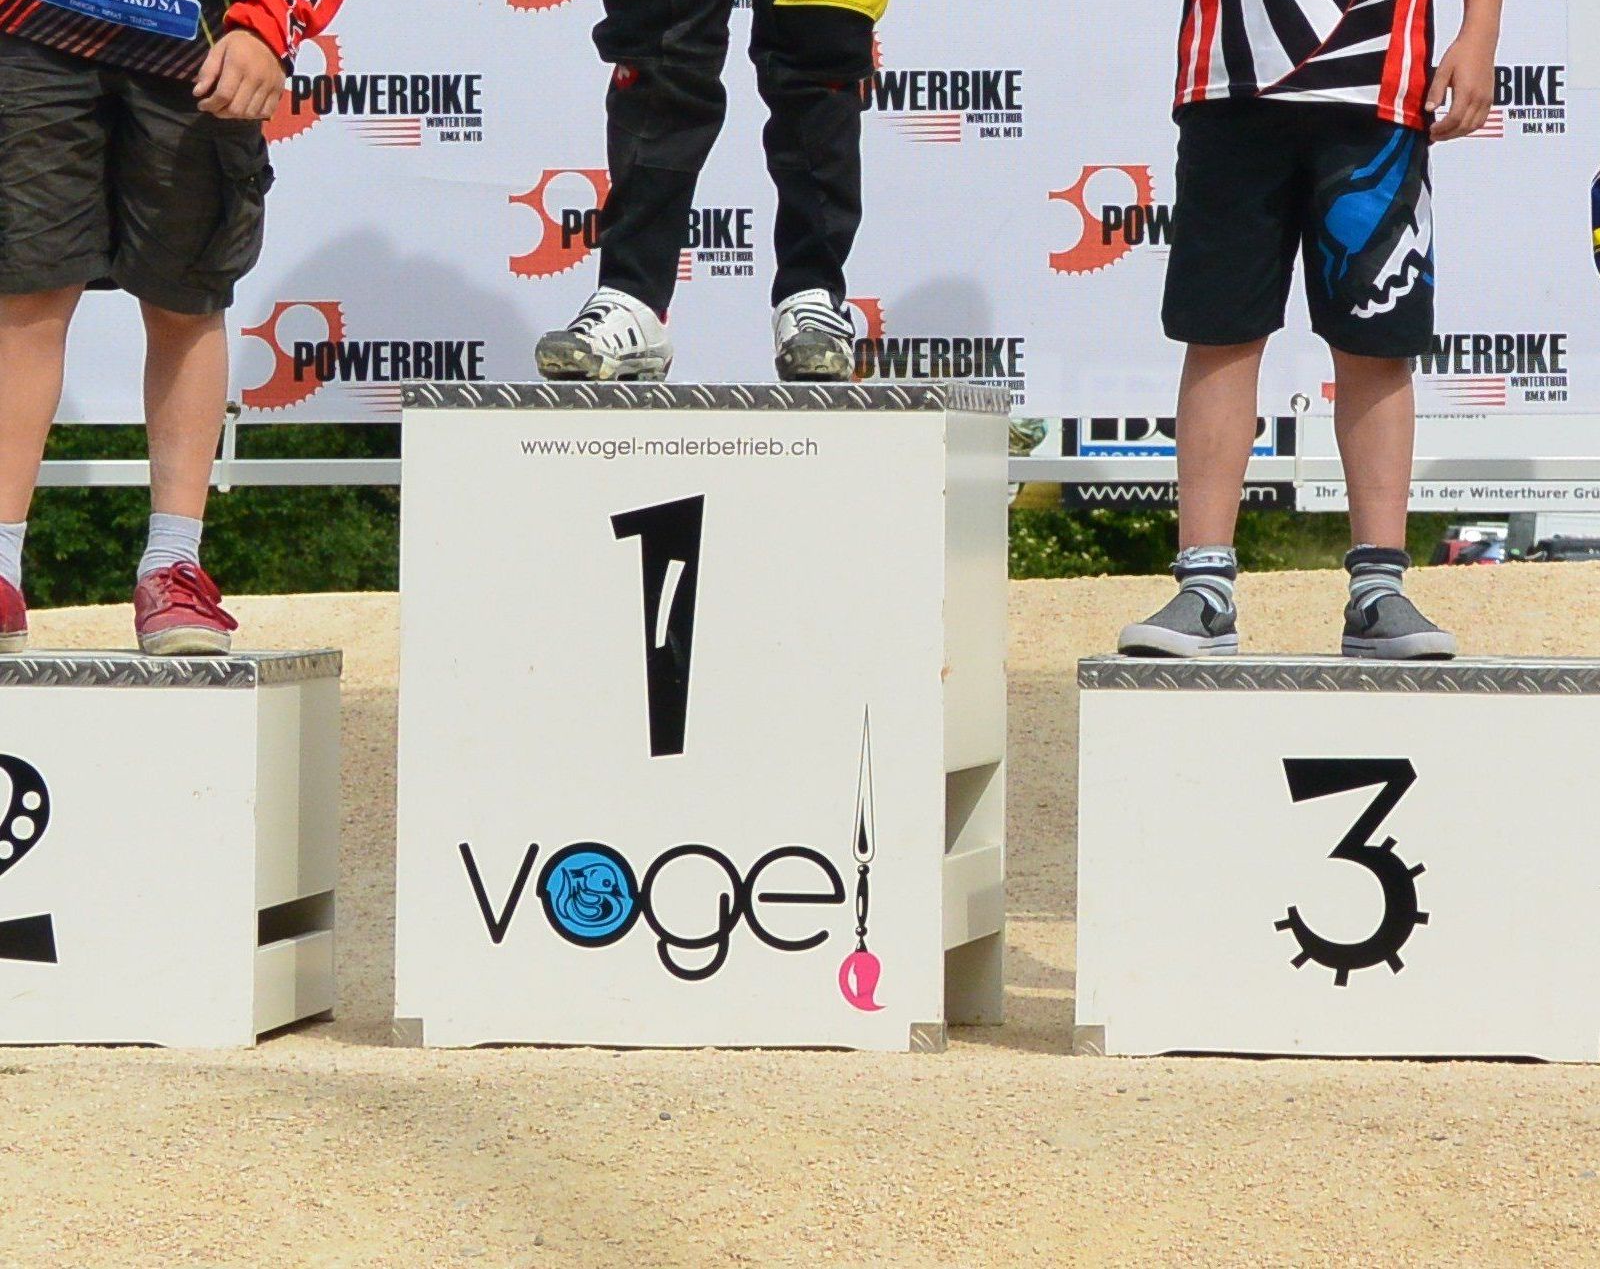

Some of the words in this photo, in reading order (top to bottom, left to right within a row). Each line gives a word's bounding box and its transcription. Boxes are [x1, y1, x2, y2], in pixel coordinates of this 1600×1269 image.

[291, 74, 482, 115] POWERBIKE
[861, 70, 1023, 111] OWERBIKE
[966, 113, 1023, 124] WINTERTHUR
[1508, 108, 1565, 119] WINTERTHUR
[426, 117, 482, 128] WINTERTHUR
[1522, 123, 1542, 133] BMX
[1546, 123, 1565, 133] MTB
[440, 132, 460, 142] BMX
[464, 131, 482, 142] MTB
[980, 128, 1001, 138] BMX
[1003, 127, 1023, 138] MTB
[697, 251, 754, 262] WINTERTHUR
[711, 266, 731, 276] BMX
[735, 265, 754, 276] MTB
[854, 337, 1025, 378] OWERBIKE
[1418, 333, 1567, 375] WERBIKE
[294, 341, 485, 382] POWERBIKE
[1511, 376, 1567, 387] WINTERTHUR
[1525, 391, 1545, 401] BMX
[1549, 391, 1567, 401] MTB
[520, 435, 818, 458] www.vogel-malerbetrieb.ch
[1315, 486, 1338, 498] Ihr
[1420, 487, 1434, 498] in
[1439, 487, 1464, 499] der
[1470, 487, 1568, 499] Winterthurer
[609, 494, 705, 758] 1
[1274, 758, 1430, 987] 3
